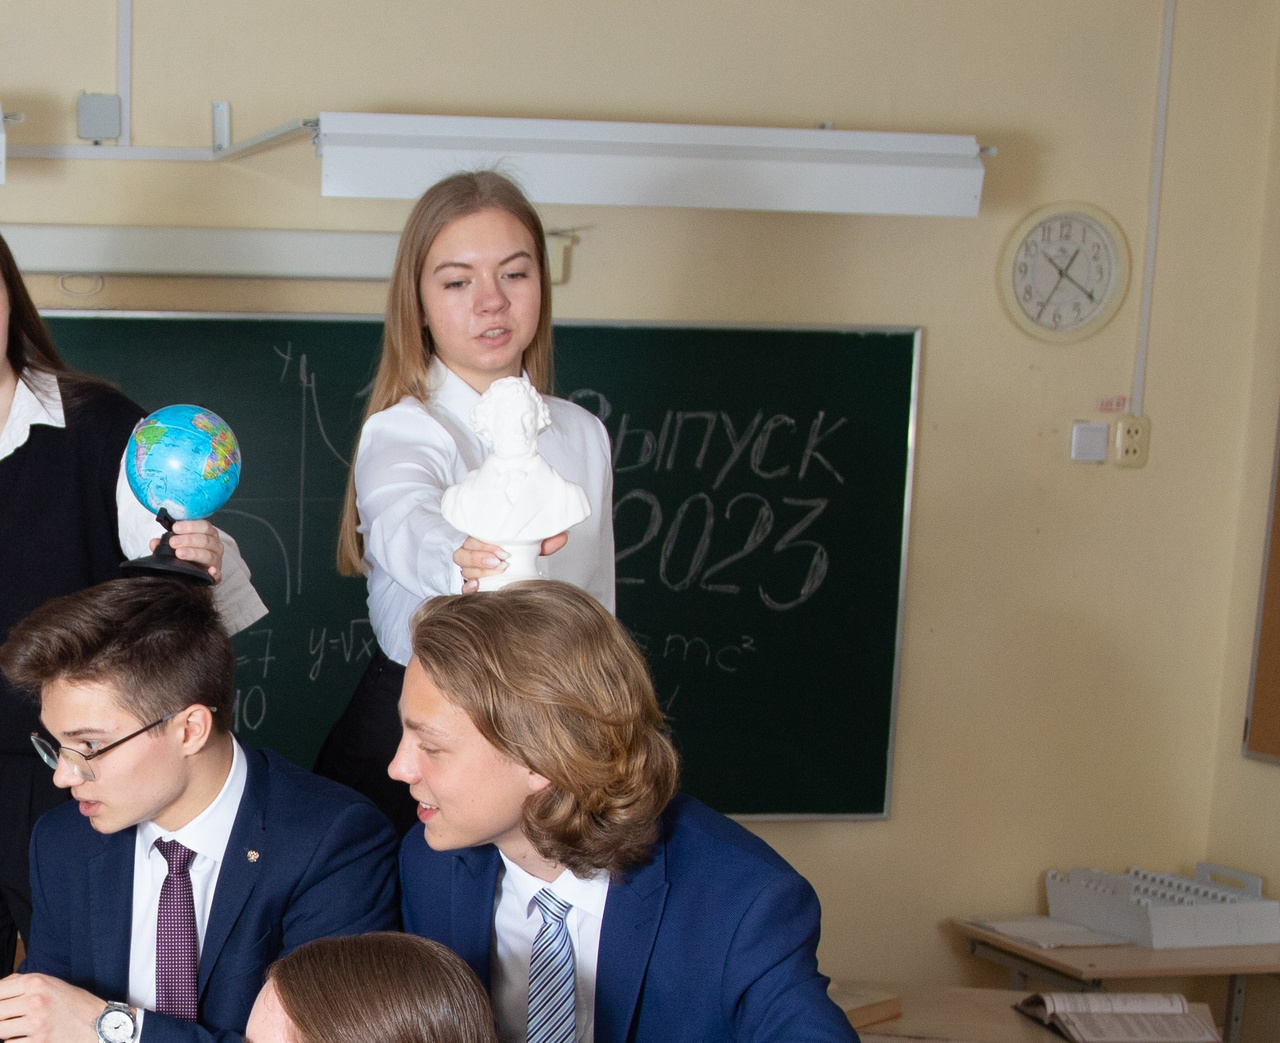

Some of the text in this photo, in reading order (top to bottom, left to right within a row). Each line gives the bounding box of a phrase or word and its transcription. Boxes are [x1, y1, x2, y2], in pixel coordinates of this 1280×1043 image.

[1059, 220, 1073, 241] 12
[1018, 262, 1029, 279] 9
[613, 488, 829, 611] 2023
